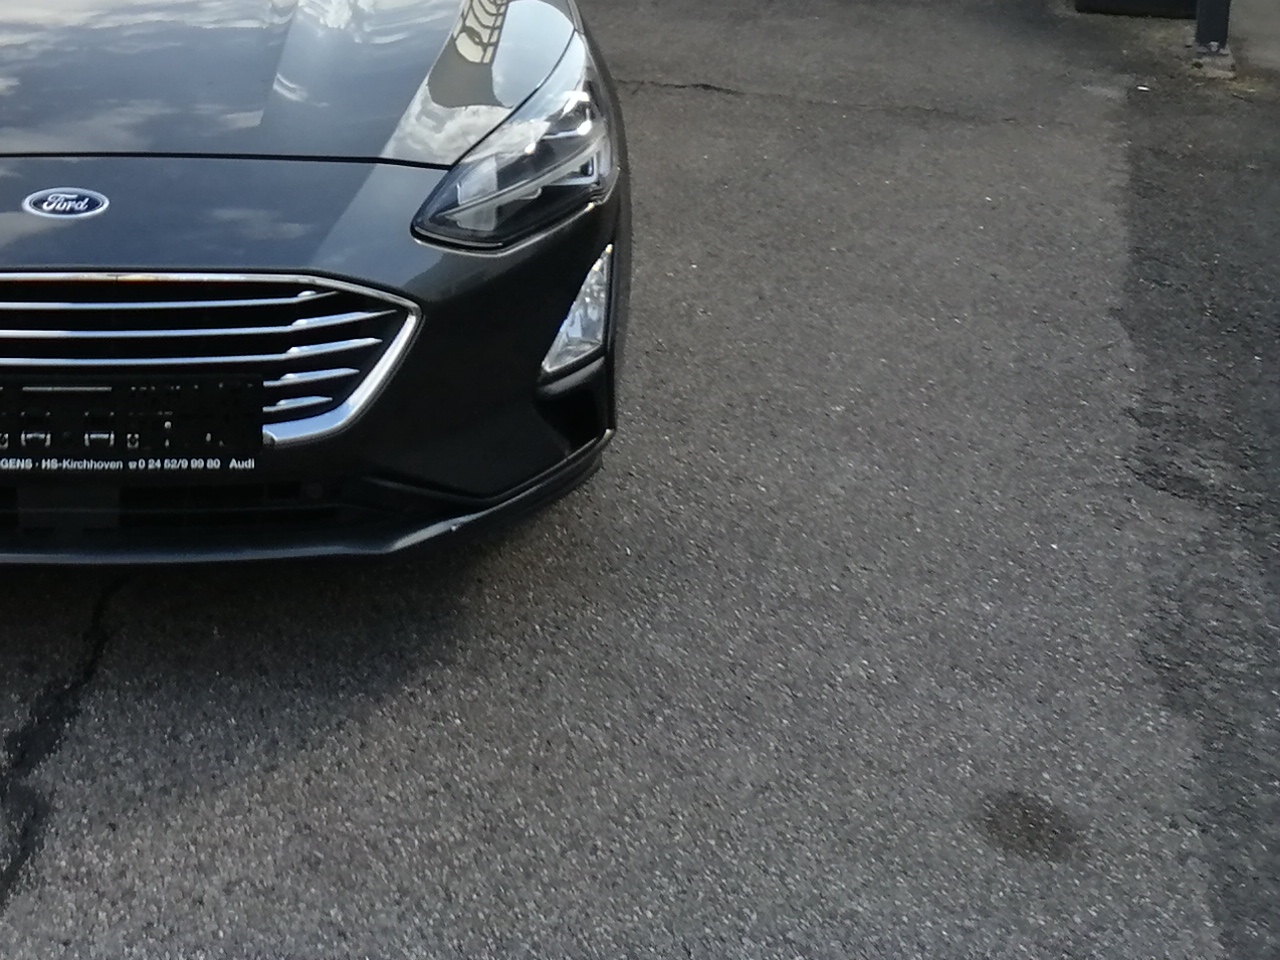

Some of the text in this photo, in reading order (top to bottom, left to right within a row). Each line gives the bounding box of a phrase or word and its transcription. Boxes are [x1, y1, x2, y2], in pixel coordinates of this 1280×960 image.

[42, 193, 90, 211] Ford
[41, 458, 124, 470] HS-Kirchhoven
[229, 457, 255, 470] Audi
